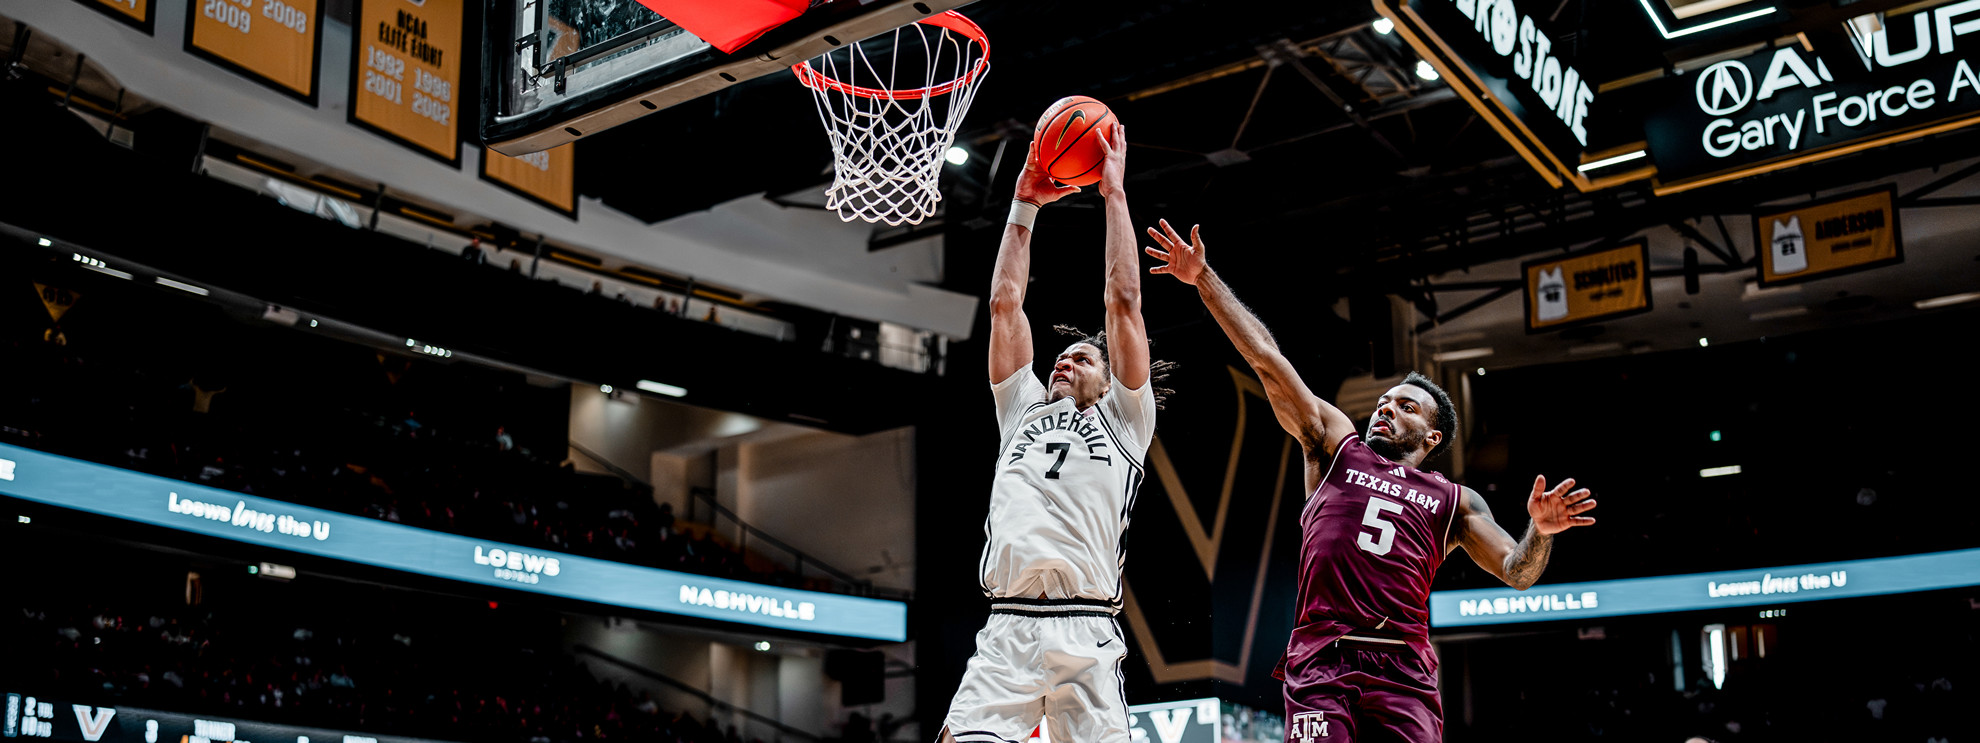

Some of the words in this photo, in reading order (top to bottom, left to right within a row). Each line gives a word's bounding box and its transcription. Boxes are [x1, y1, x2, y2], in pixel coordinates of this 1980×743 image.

[378, 21, 407, 53] ELITE
[410, 38, 443, 69] EIGHT
[397, 9, 428, 40] NCAA
[1514, 15, 1595, 147] STONE
[1702, 108, 1806, 158] Gary
[1812, 78, 1936, 134] Force
[1008, 411, 1112, 466] VANDERBILT
[1045, 442, 1071, 479] 7
[1345, 468, 1403, 497] TEXAS
[1404, 488, 1441, 515] A&M
[168, 492, 231, 522] Loews
[277, 515, 311, 538] the
[313, 520, 330, 541] U
[1357, 496, 1404, 556] 5
[474, 545, 560, 577] LOEWS
[1832, 571, 1847, 587] U
[679, 585, 816, 621] NASHVILLE
[1459, 591, 1599, 617] NASHVILLE
